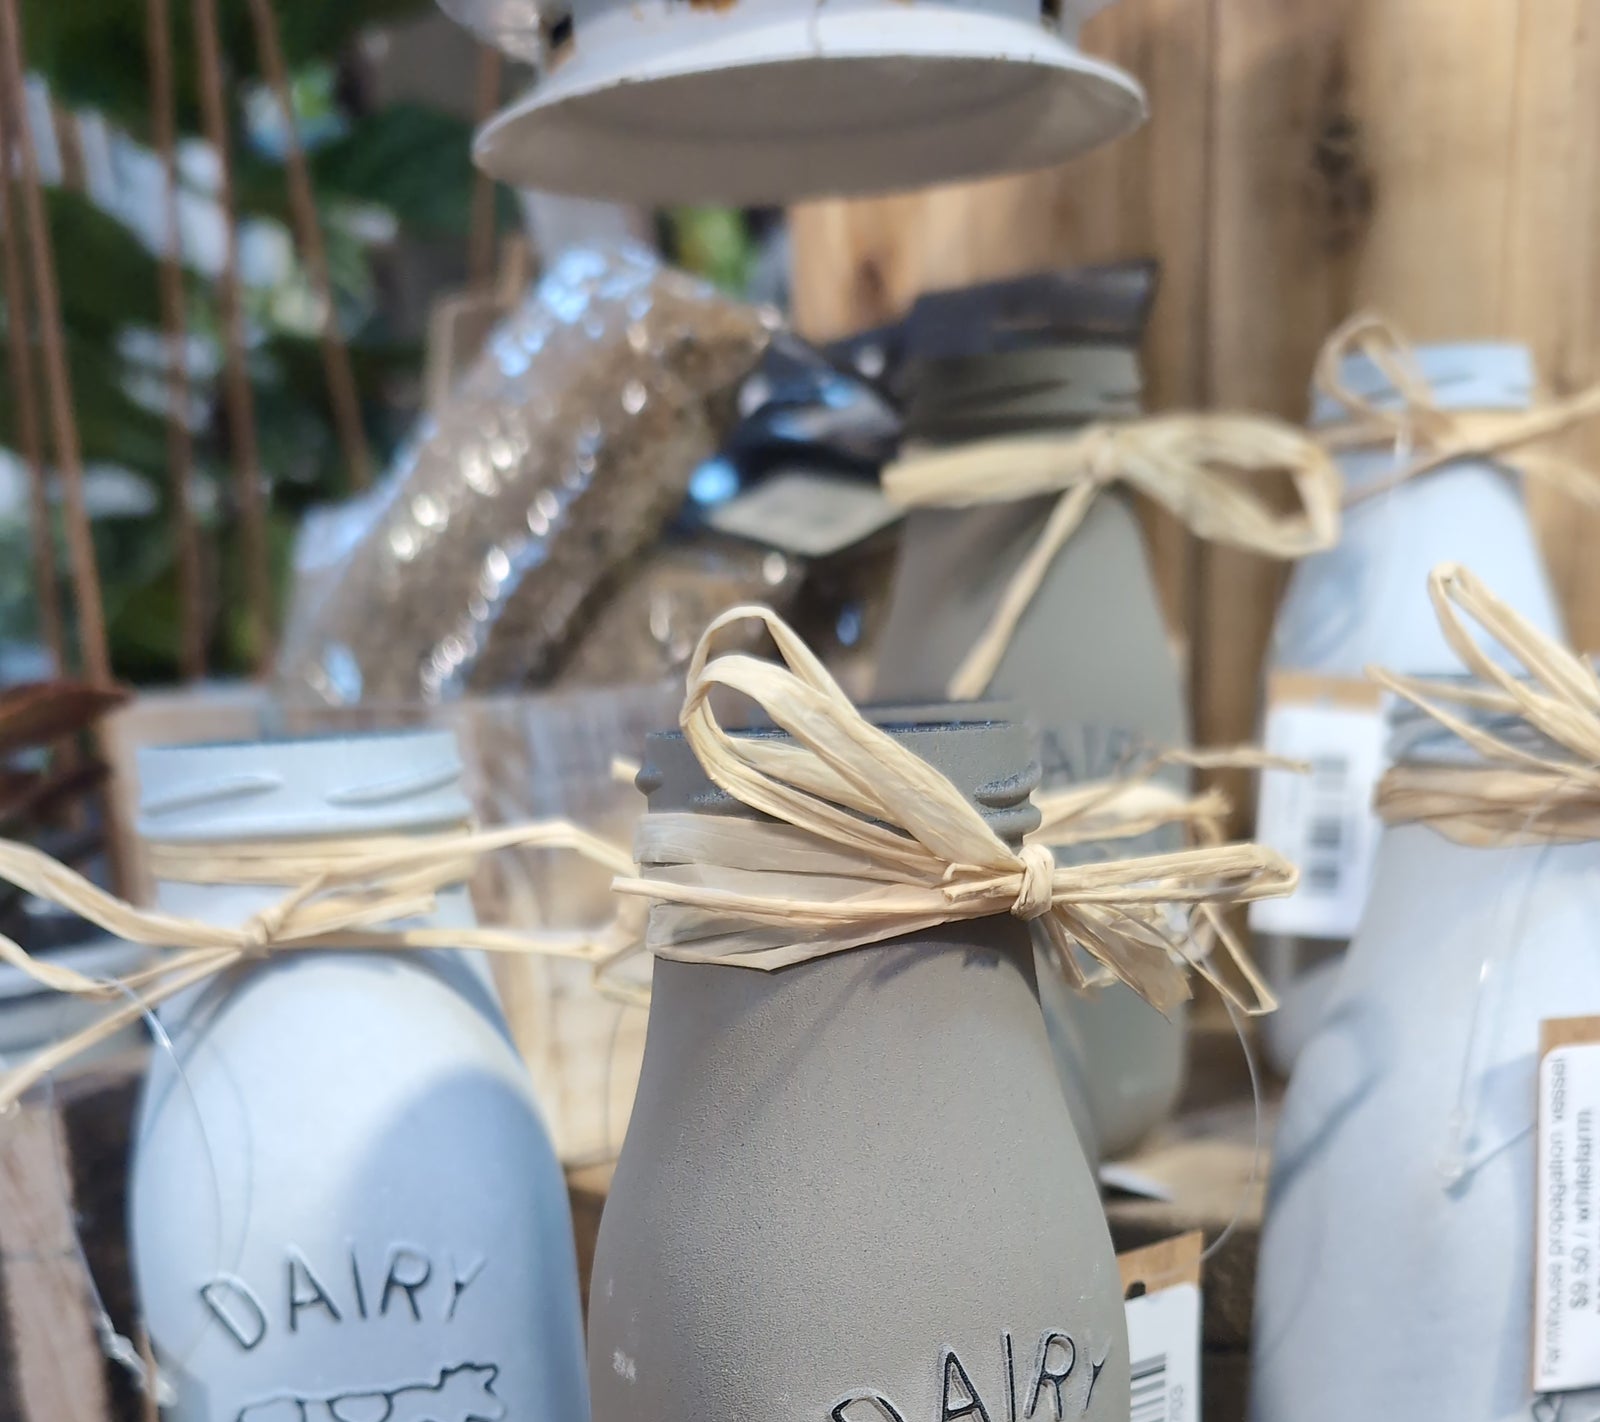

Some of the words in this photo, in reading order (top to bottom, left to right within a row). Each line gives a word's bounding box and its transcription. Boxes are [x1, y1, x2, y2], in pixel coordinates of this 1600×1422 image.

[1549, 1058, 1565, 1125] vessel
[1547, 1131, 1566, 1257] propagation
[1573, 1108, 1591, 1224] whitefarm
[199, 1243, 487, 1351] DAIRY
